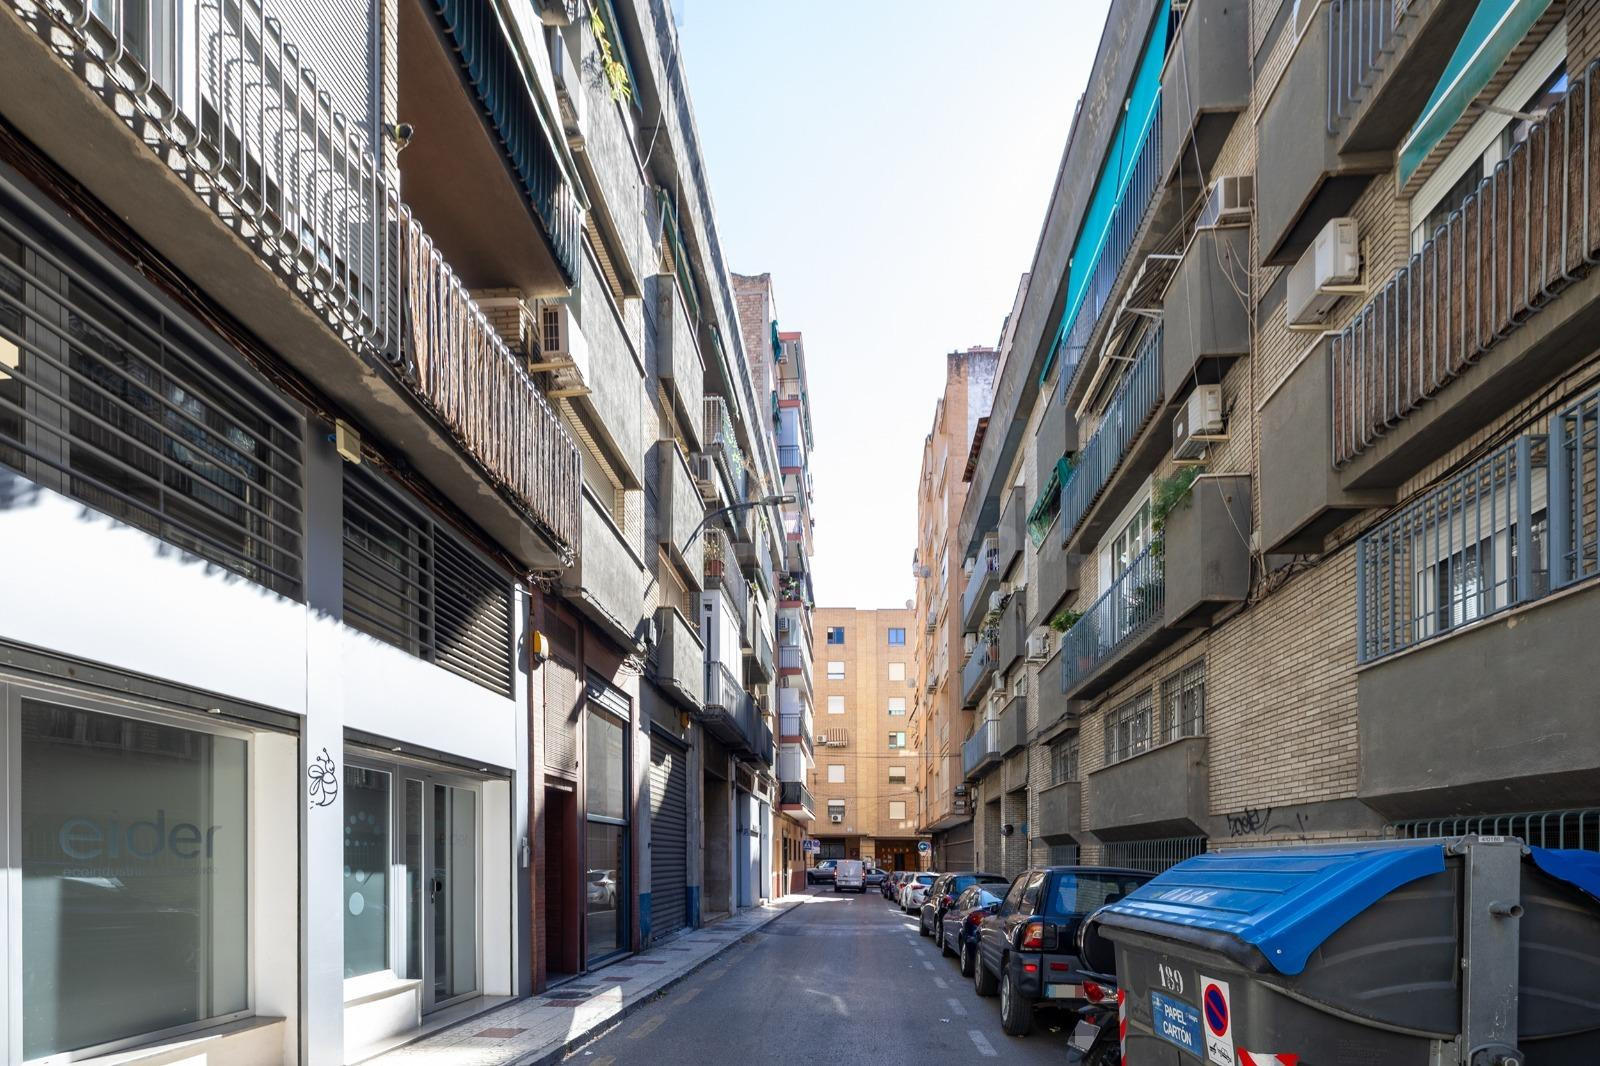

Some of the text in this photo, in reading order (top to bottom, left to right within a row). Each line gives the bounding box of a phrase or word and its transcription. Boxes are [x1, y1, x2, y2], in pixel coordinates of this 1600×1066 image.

[59, 809, 223, 860] eider
[1158, 963, 1184, 995] 189
[1164, 1004, 1187, 1026] PAPEL
[1162, 1021, 1192, 1047] CARTÓN
